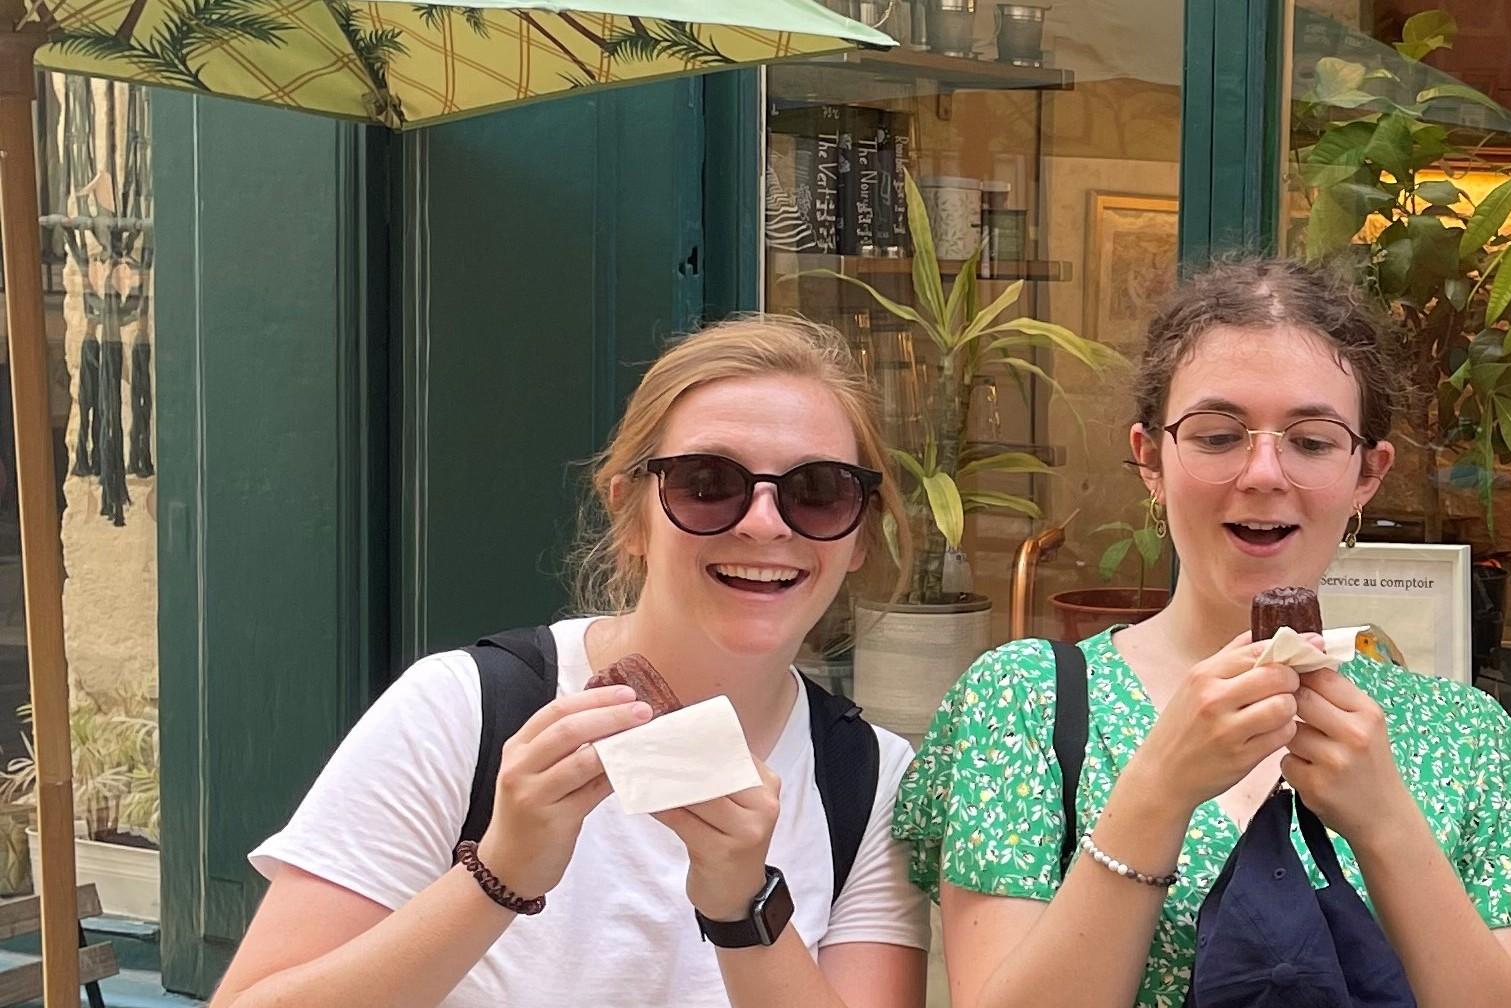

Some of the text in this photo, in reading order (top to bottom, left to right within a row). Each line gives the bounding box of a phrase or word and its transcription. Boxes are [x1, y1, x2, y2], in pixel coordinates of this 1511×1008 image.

[817, 162, 838, 194] Vert
[1320, 576, 1435, 591] Service au comptoir
